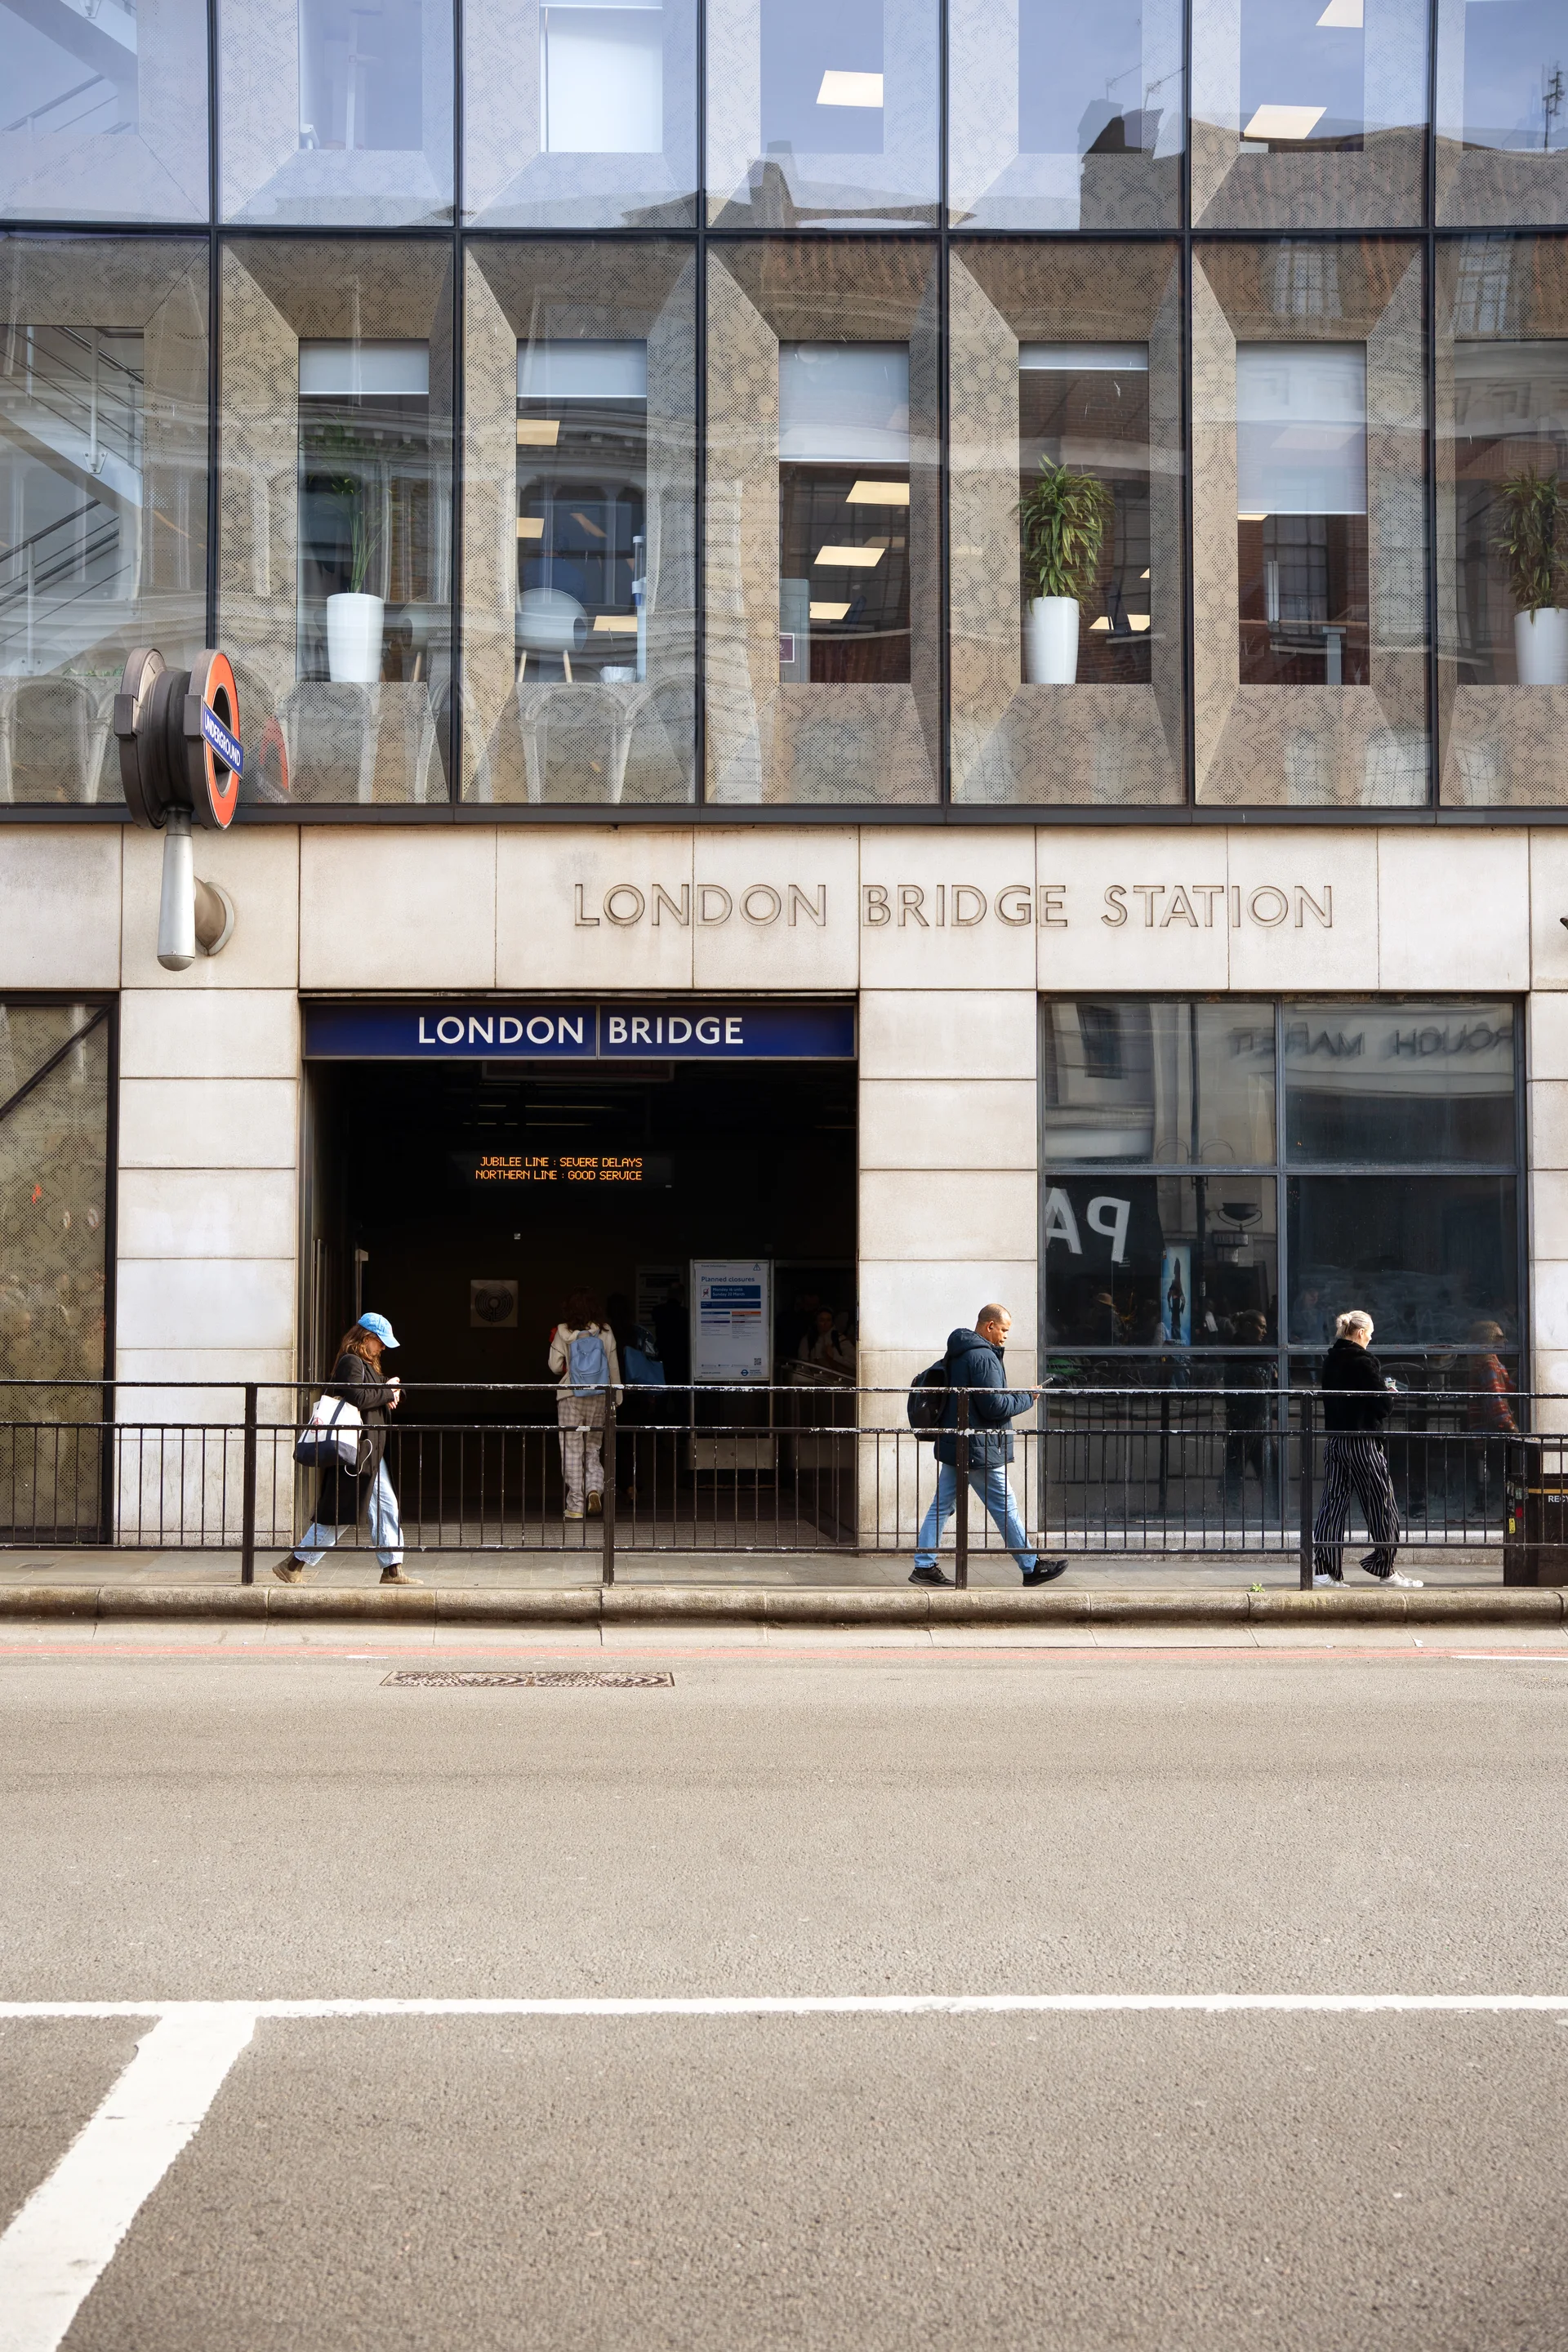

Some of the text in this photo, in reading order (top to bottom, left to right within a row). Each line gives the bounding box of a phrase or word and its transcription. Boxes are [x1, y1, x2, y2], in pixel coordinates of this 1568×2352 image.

[204, 710, 241, 767] UNDERGROUND
[575, 884, 1334, 928] LONDON BRIDGE STATION
[418, 1016, 744, 1045] LONDON BRIDGE
[475, 1169, 531, 1180] NORTHERN
[533, 1170, 558, 1180] LINE
[568, 1170, 596, 1180] GOOD
[599, 1170, 643, 1181] SERVICE
[480, 1156, 522, 1167] JUBILEE
[525, 1157, 550, 1167] LINE
[559, 1157, 599, 1167] SEVERE
[602, 1157, 643, 1167] DELAYS
